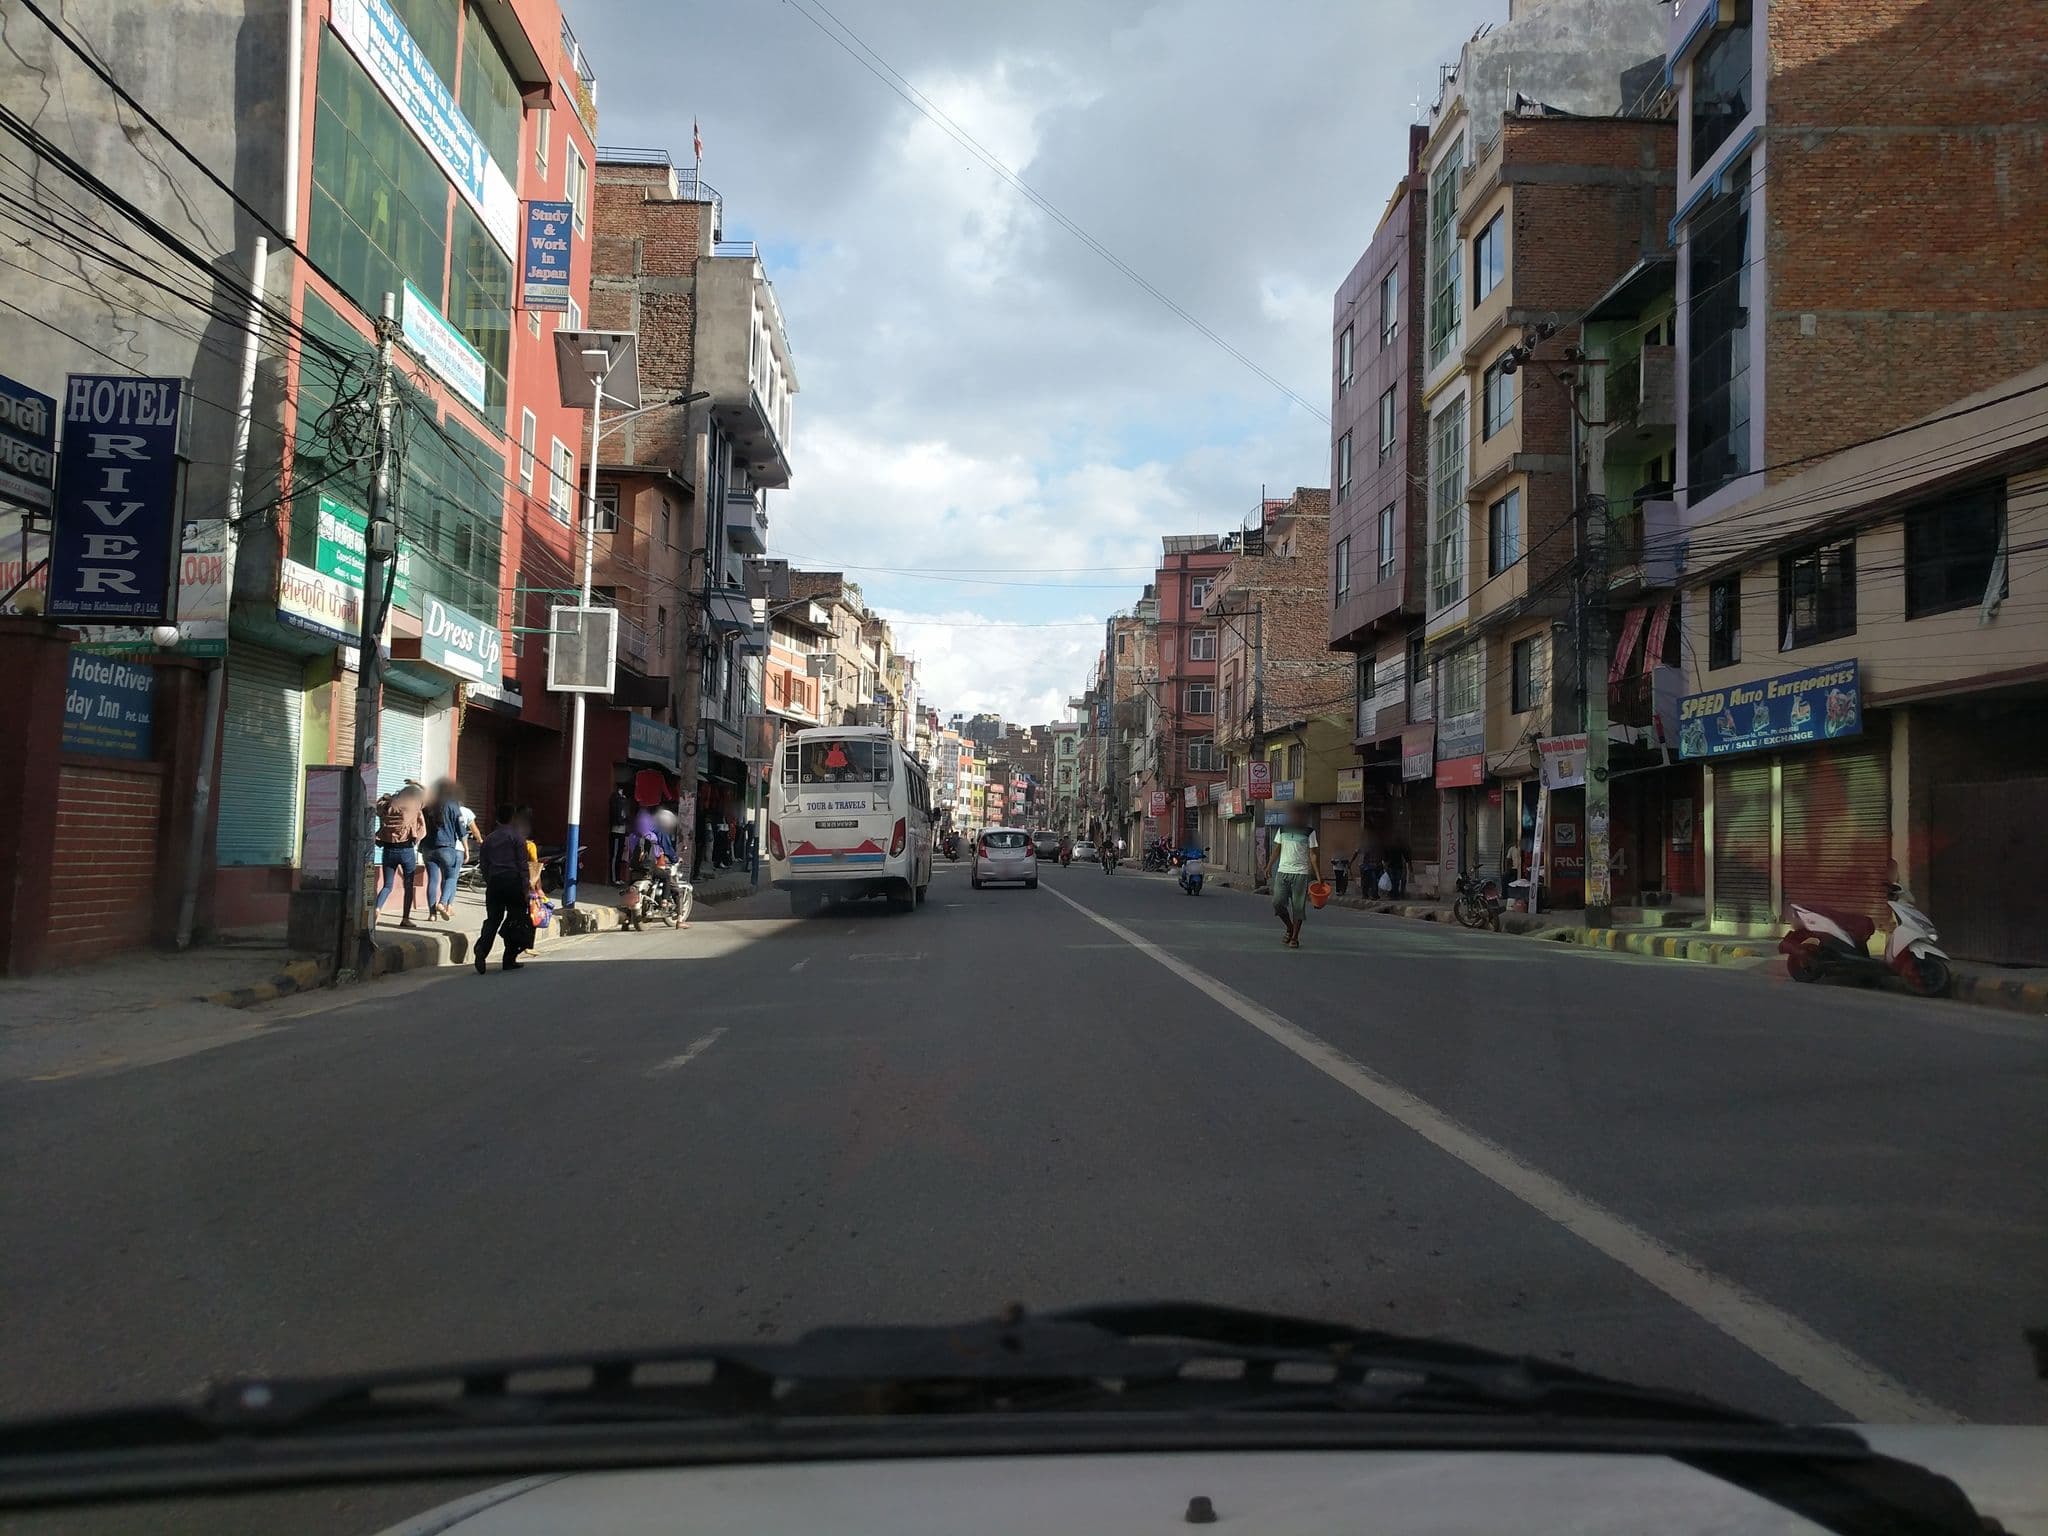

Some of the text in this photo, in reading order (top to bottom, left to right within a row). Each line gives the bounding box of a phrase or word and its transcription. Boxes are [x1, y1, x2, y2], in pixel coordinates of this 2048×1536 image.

[401, 34, 412, 58] &
[413, 46, 437, 95] Work
[438, 84, 448, 110] in
[448, 104, 473, 147] Japan
[531, 208, 569, 224] Study
[543, 223, 556, 236] &
[531, 237, 568, 251] Work
[541, 252, 555, 264] in
[528, 266, 568, 281] Japan
[67, 378, 176, 426] HOTEL
[75, 433, 151, 594] RIVER
[53, 600, 79, 612] Holiday
[80, 601, 92, 611] Inn
[93, 601, 132, 612] Kathmandu
[147, 602, 160, 613] Ltd.
[426, 601, 499, 674] Dress Up
[71, 656, 153, 692] Hotel River
[97, 695, 120, 719] Inn
[1680, 693, 1725, 721] SPEED
[1713, 743, 1730, 753] BUY
[1736, 740, 1758, 750] SALE
[1763, 731, 1814, 745] EXCHANGE
[807, 801, 866, 811] TOUR & TRAVELS
